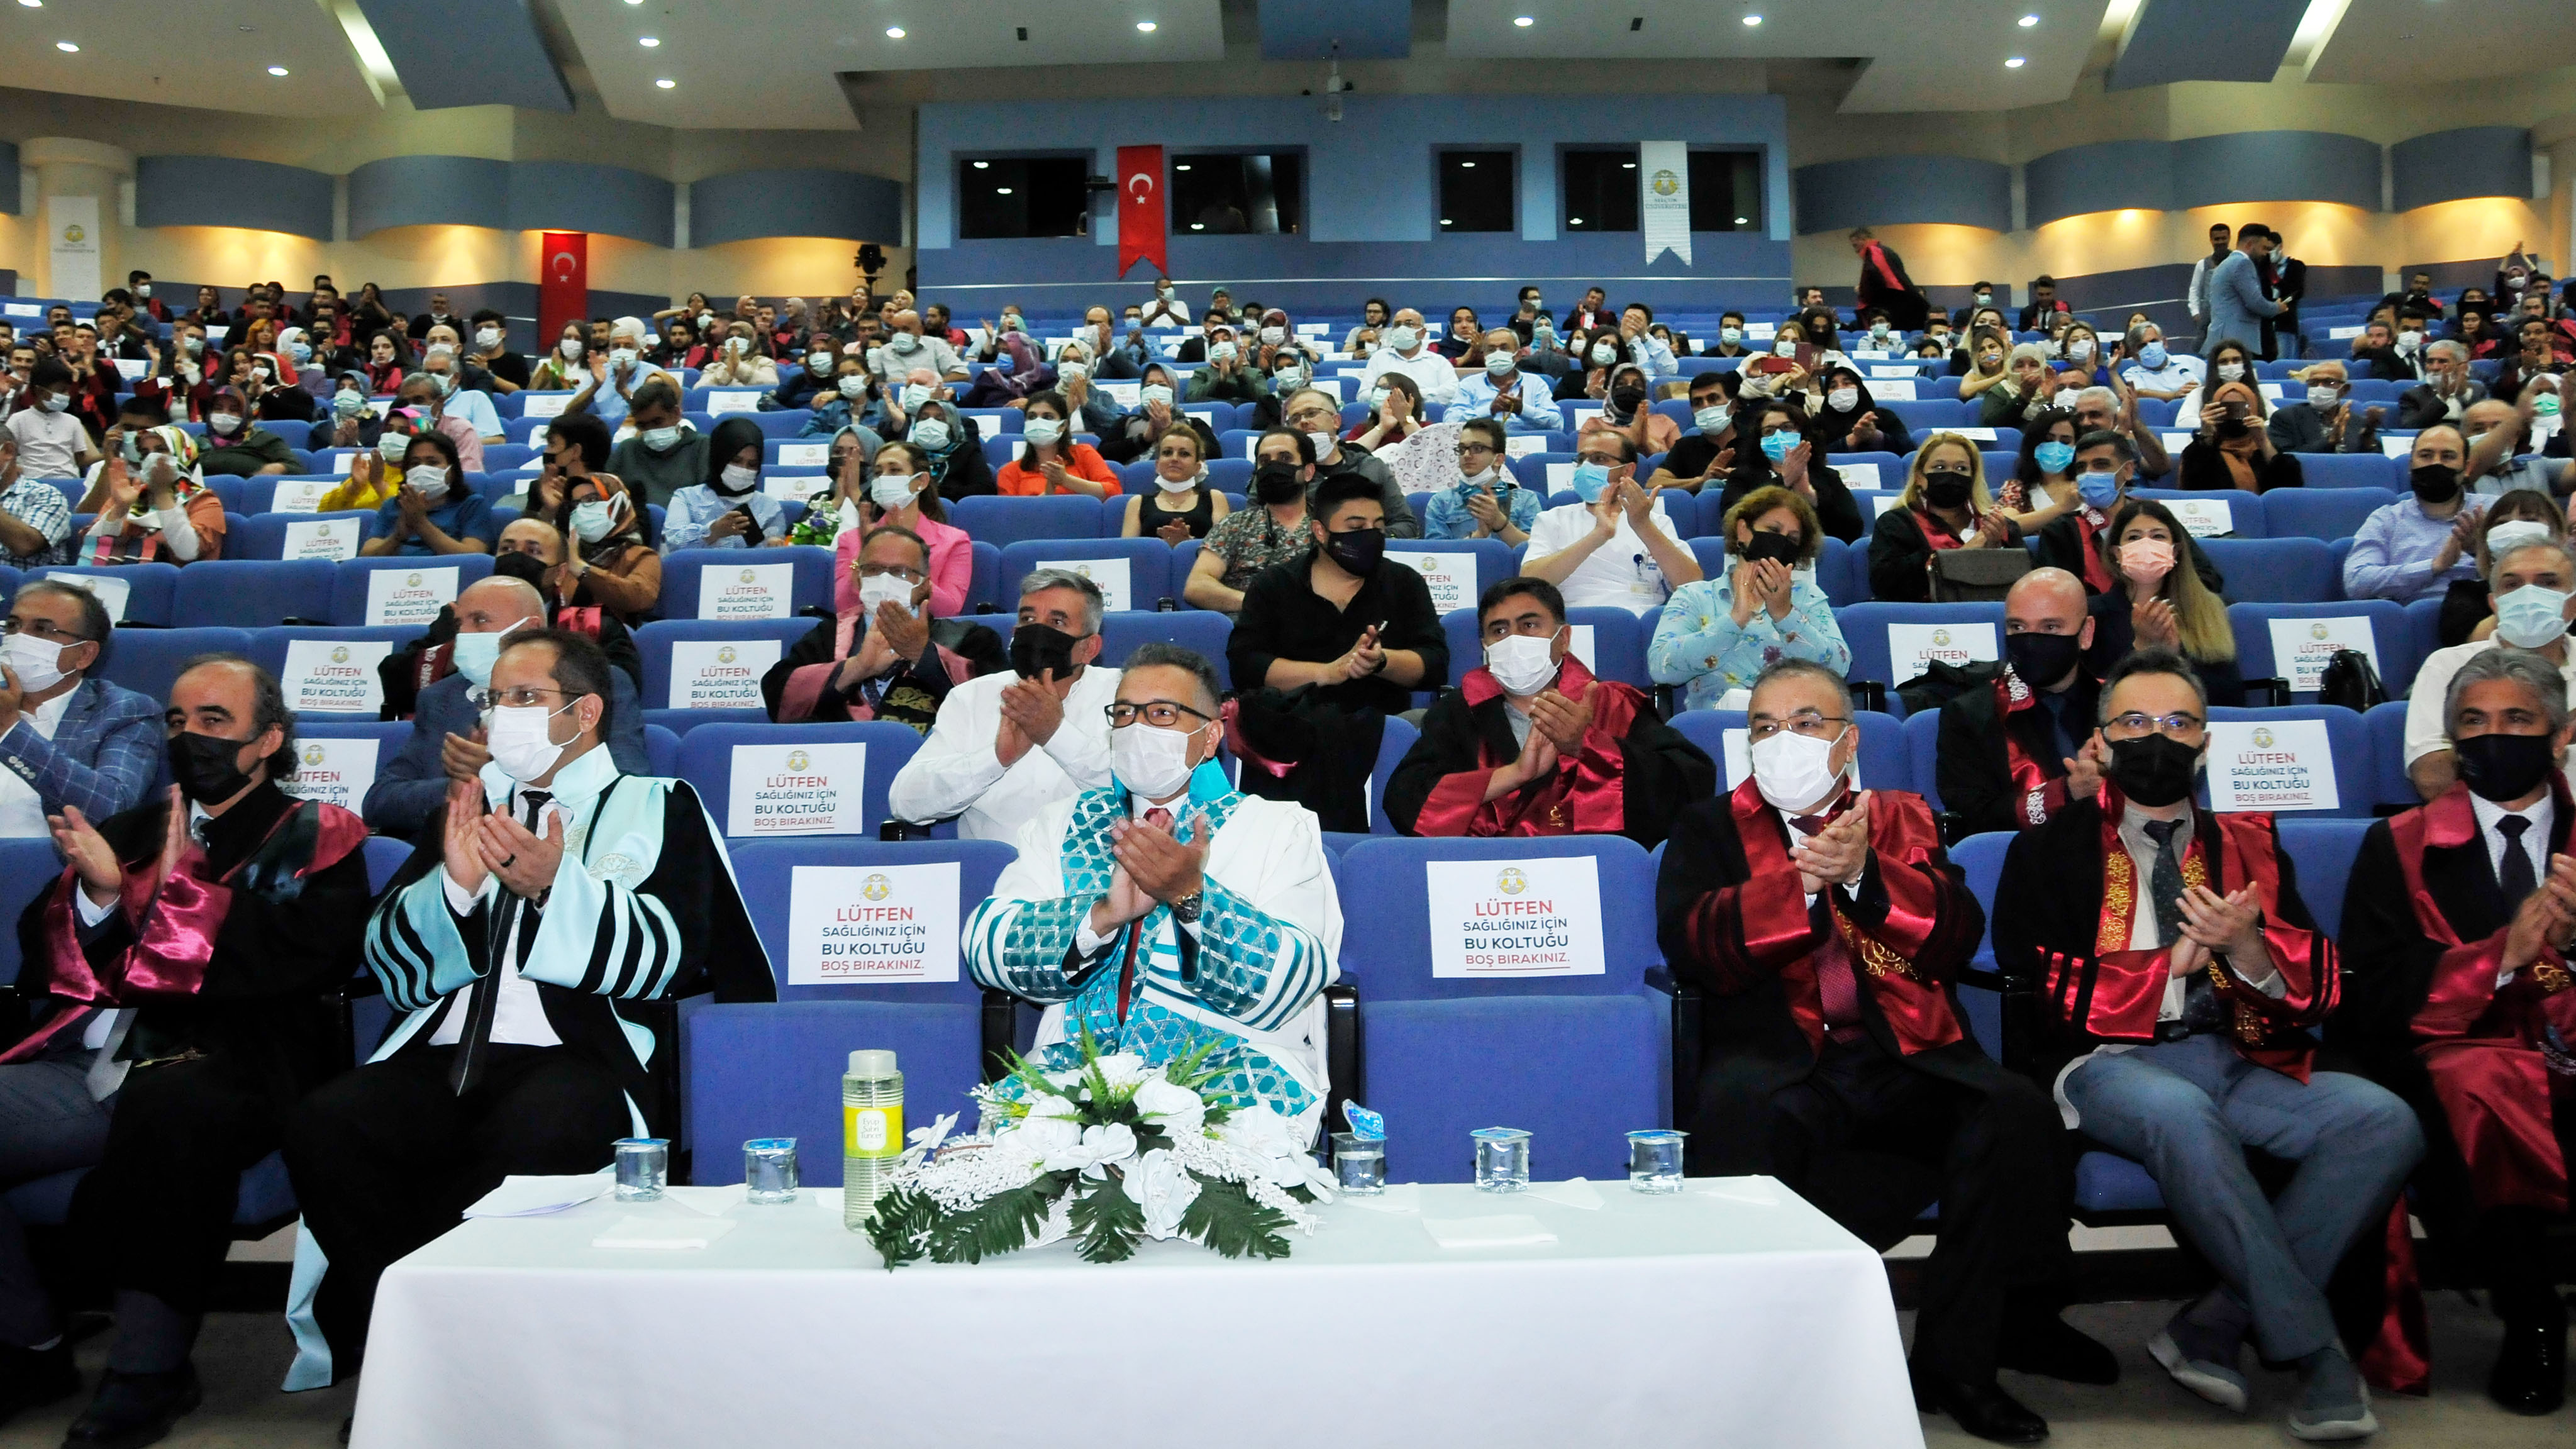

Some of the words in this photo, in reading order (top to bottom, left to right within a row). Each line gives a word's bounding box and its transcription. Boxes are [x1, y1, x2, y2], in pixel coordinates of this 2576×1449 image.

[393, 589, 433, 599] LÜTFEN
[726, 585, 767, 595] LÜTFEN
[732, 604, 774, 613] KOLTUĞU
[1919, 648, 1968, 660] LÜTFEN
[314, 665, 362, 676] LÜTFEN
[701, 665, 750, 677] LÜTFEN
[691, 678, 739, 687] SAĞLIĞINIZ
[319, 687, 367, 697] KOLTUĞU
[709, 687, 758, 698] KOLTUĞU
[2238, 750, 2296, 764] LÜTFEN
[2231, 766, 2285, 775] SAĞLIĞINIZ
[2287, 765, 2308, 777] İÇİN
[767, 774, 828, 788] LÜTFEN
[2233, 780, 2250, 790] BU
[2253, 777, 2310, 790] KOLTUĞU
[284, 784, 327, 794] ĞLIĞINIZ
[755, 790, 814, 800] SAĞLIĞINIZ
[816, 789, 837, 801] İÇİN
[2235, 794, 2257, 804] BOŞ
[755, 805, 773, 814] BU
[777, 801, 836, 814] KOLTUĞU
[754, 818, 777, 828] BOŞ
[836, 904, 913, 922] LÜTFEN
[1475, 898, 1553, 916] LÜTFEN
[1463, 919, 1538, 931] SAĞLIĞINIZ
[1541, 916, 1568, 932] İÇİN
[822, 924, 897, 937] SAĞLIĞINIZ
[900, 923, 926, 940] İÇİN
[821, 943, 845, 955] BU
[849, 938, 925, 955] KOLTUĞU
[1464, 938, 1487, 950] BU
[1492, 933, 1568, 949] KOLTUĞU
[1466, 955, 1494, 967] BOŞ
[1498, 952, 1571, 964] BIRAKINIZ.
[821, 961, 850, 974] BOŞ
[853, 960, 924, 970] BIRAKINIZ.
